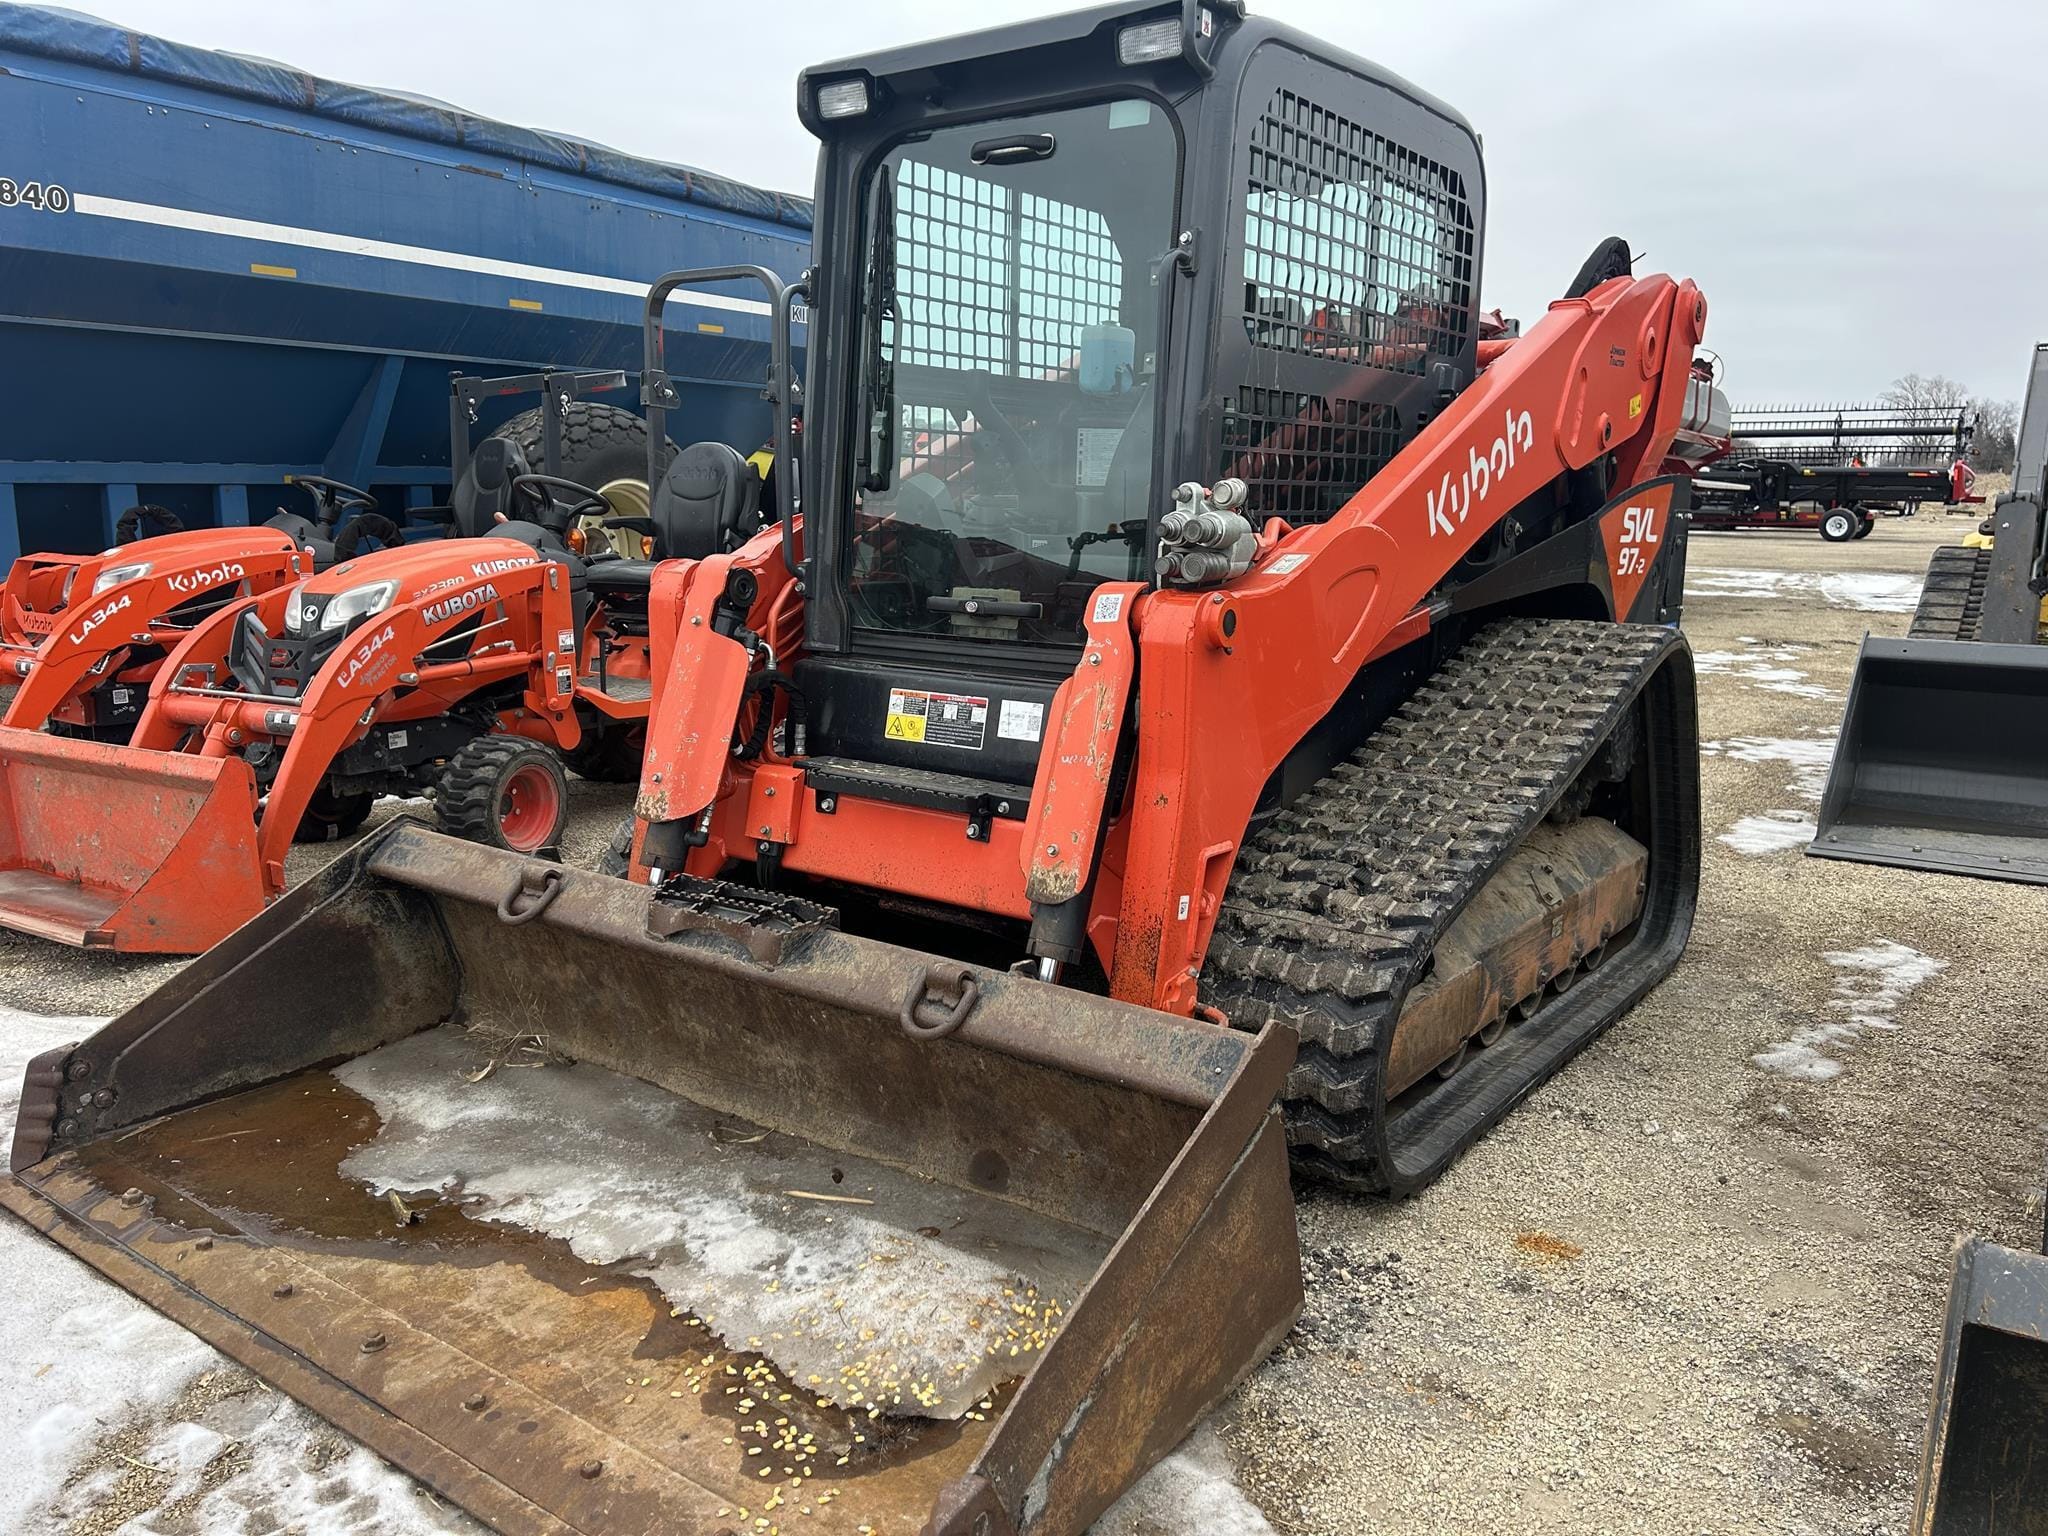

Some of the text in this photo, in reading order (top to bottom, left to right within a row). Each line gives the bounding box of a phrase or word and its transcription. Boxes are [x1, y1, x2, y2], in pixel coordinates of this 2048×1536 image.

[0, 177, 70, 213] 840
[1427, 408, 1533, 537] Kubota
[1620, 507, 1658, 543] SVL
[167, 562, 245, 592] Kubota
[22, 614, 54, 632] Kubota
[69, 594, 132, 645] LA344
[422, 583, 499, 626] KUBOTA
[337, 625, 395, 688] LA344
